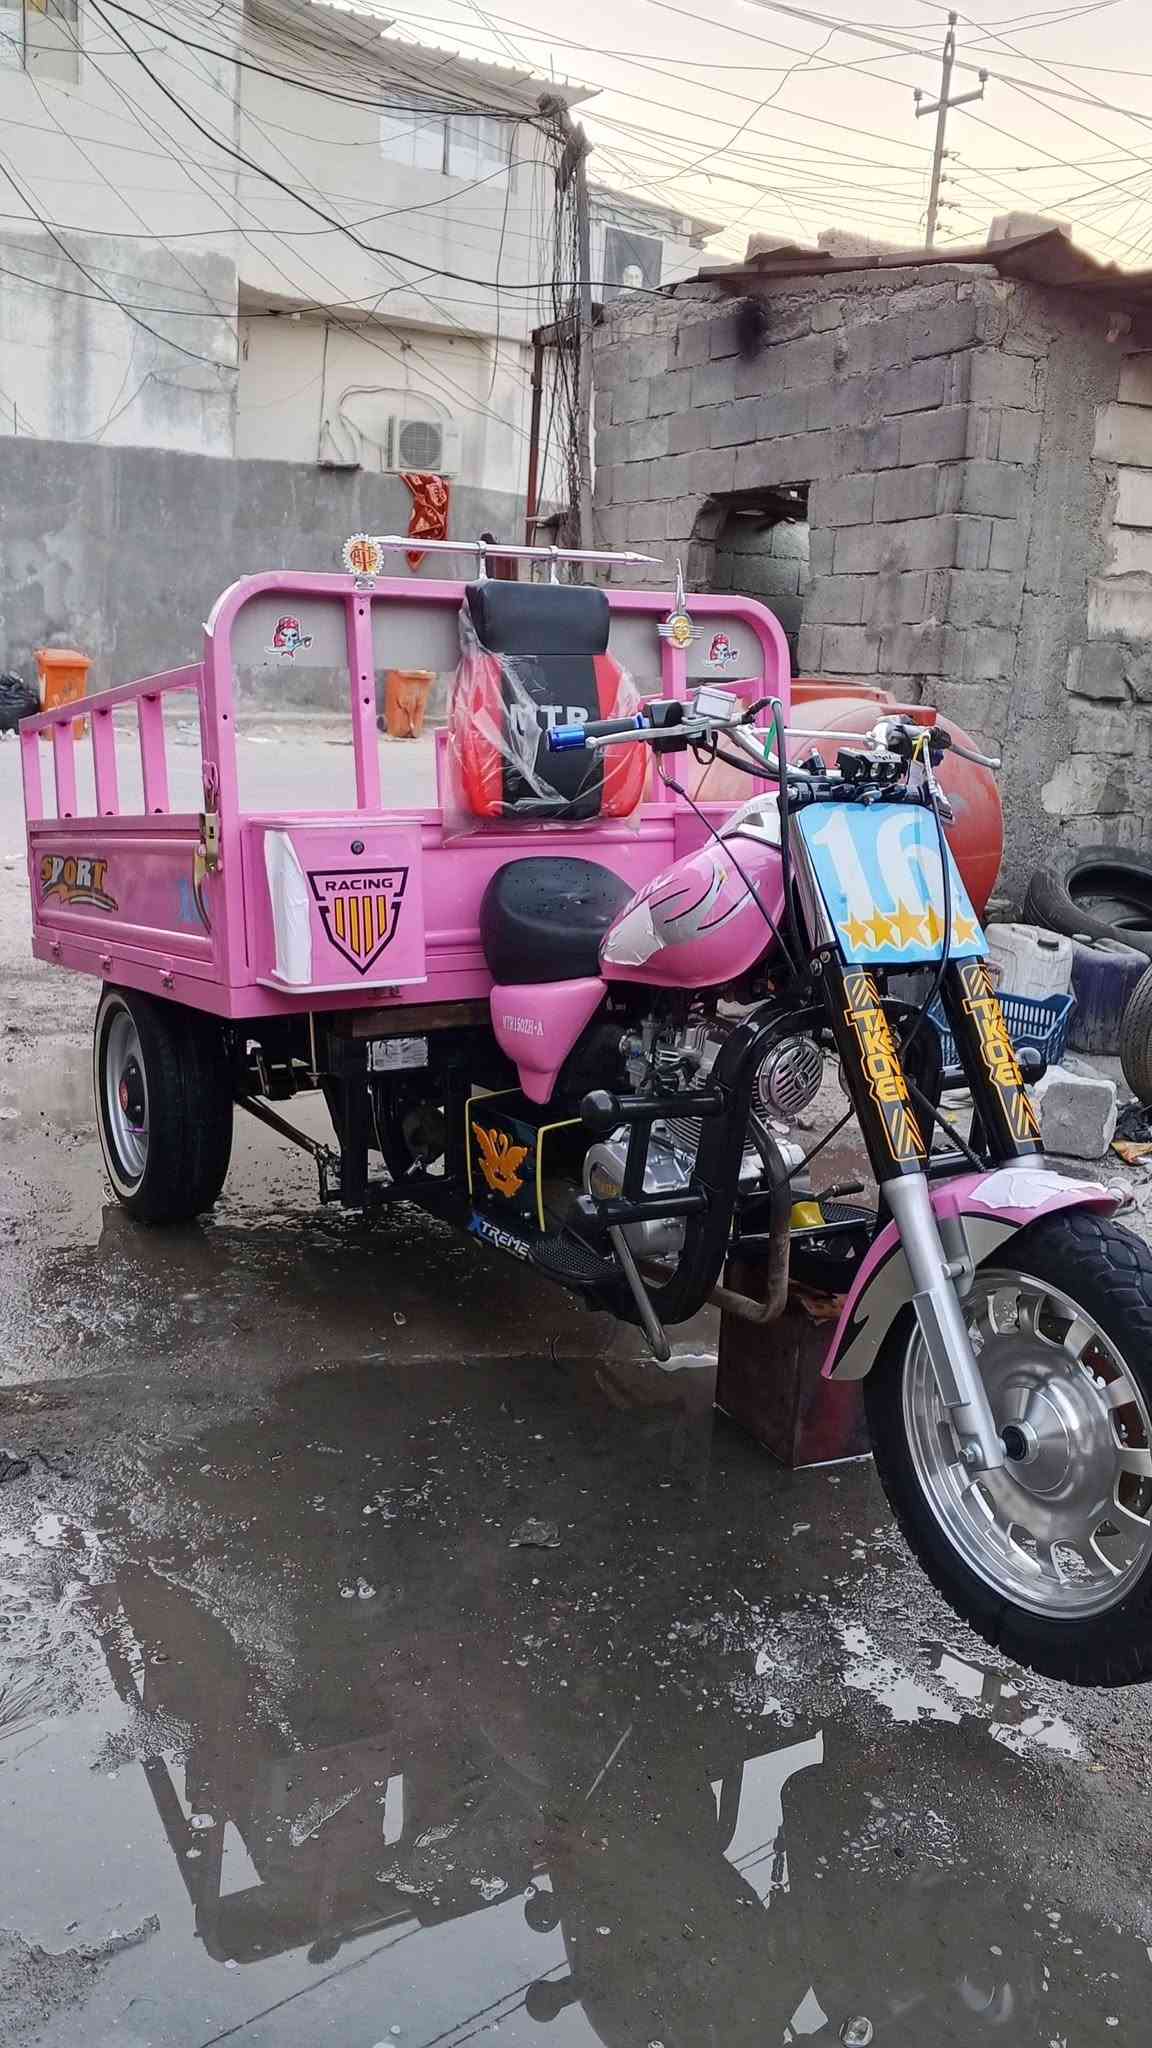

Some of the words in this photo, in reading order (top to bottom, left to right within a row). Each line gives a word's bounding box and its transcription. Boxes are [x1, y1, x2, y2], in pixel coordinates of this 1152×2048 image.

[41, 855, 107, 892] SPORT
[325, 878, 393, 891] RACING
[811, 810, 951, 922] 16
[467, 1215, 530, 1257] XTREME
